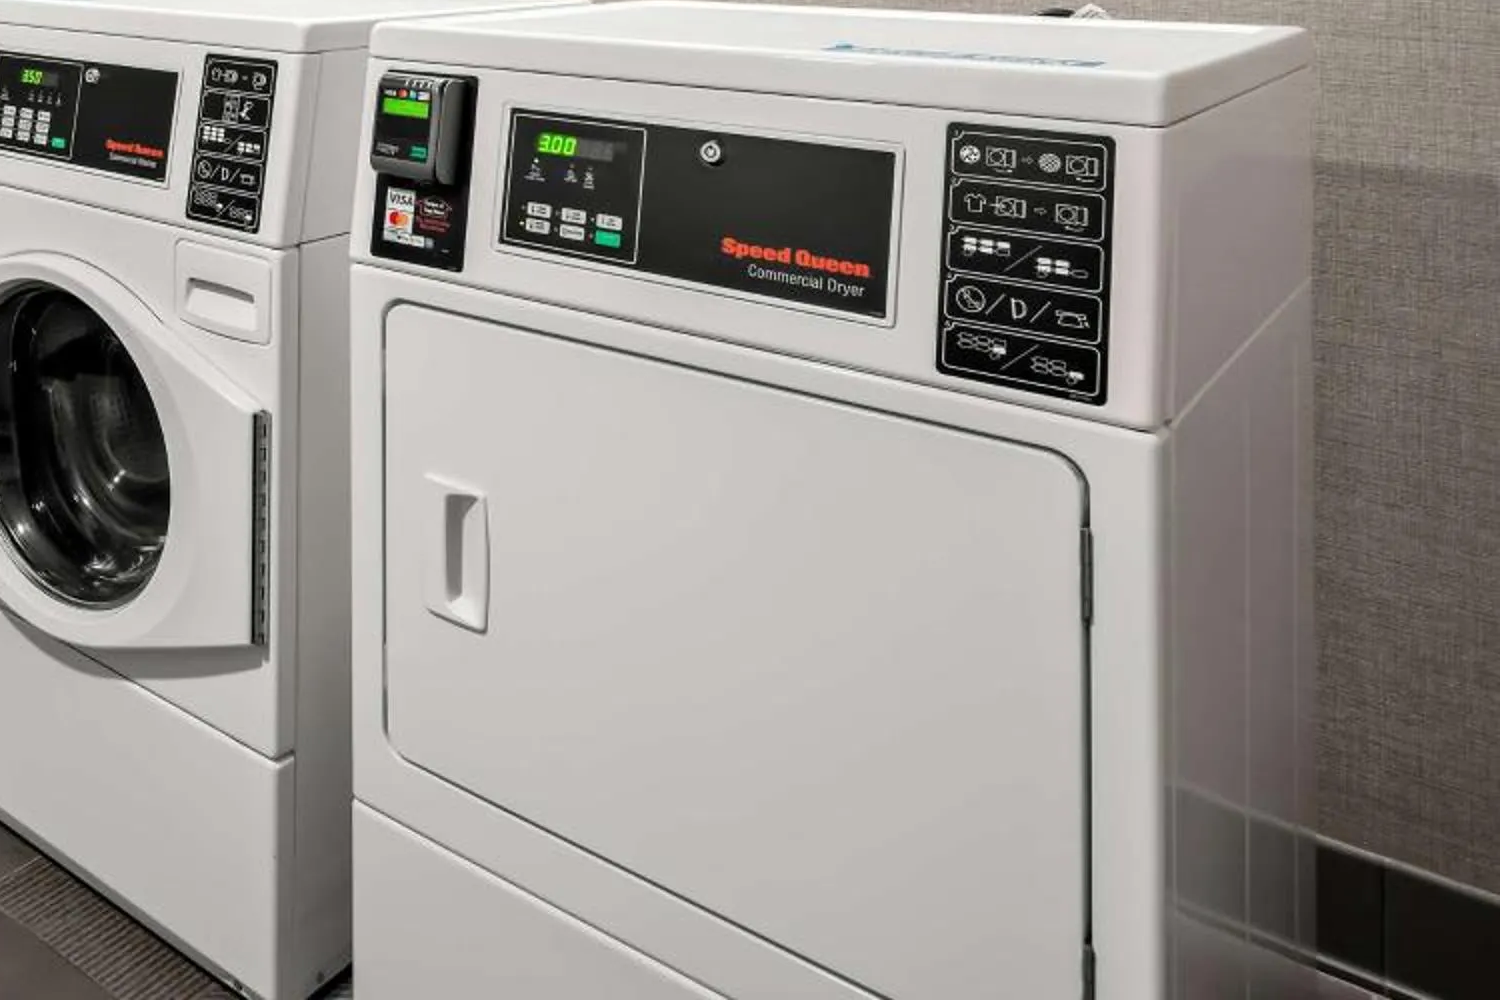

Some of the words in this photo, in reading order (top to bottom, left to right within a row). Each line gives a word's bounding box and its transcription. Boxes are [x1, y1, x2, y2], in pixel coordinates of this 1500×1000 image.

[389, 191, 414, 206] VISA
[721, 236, 792, 264] Speed
[795, 248, 871, 278] Queen
[747, 263, 823, 290] Commercial
[827, 277, 866, 297] Dryer
